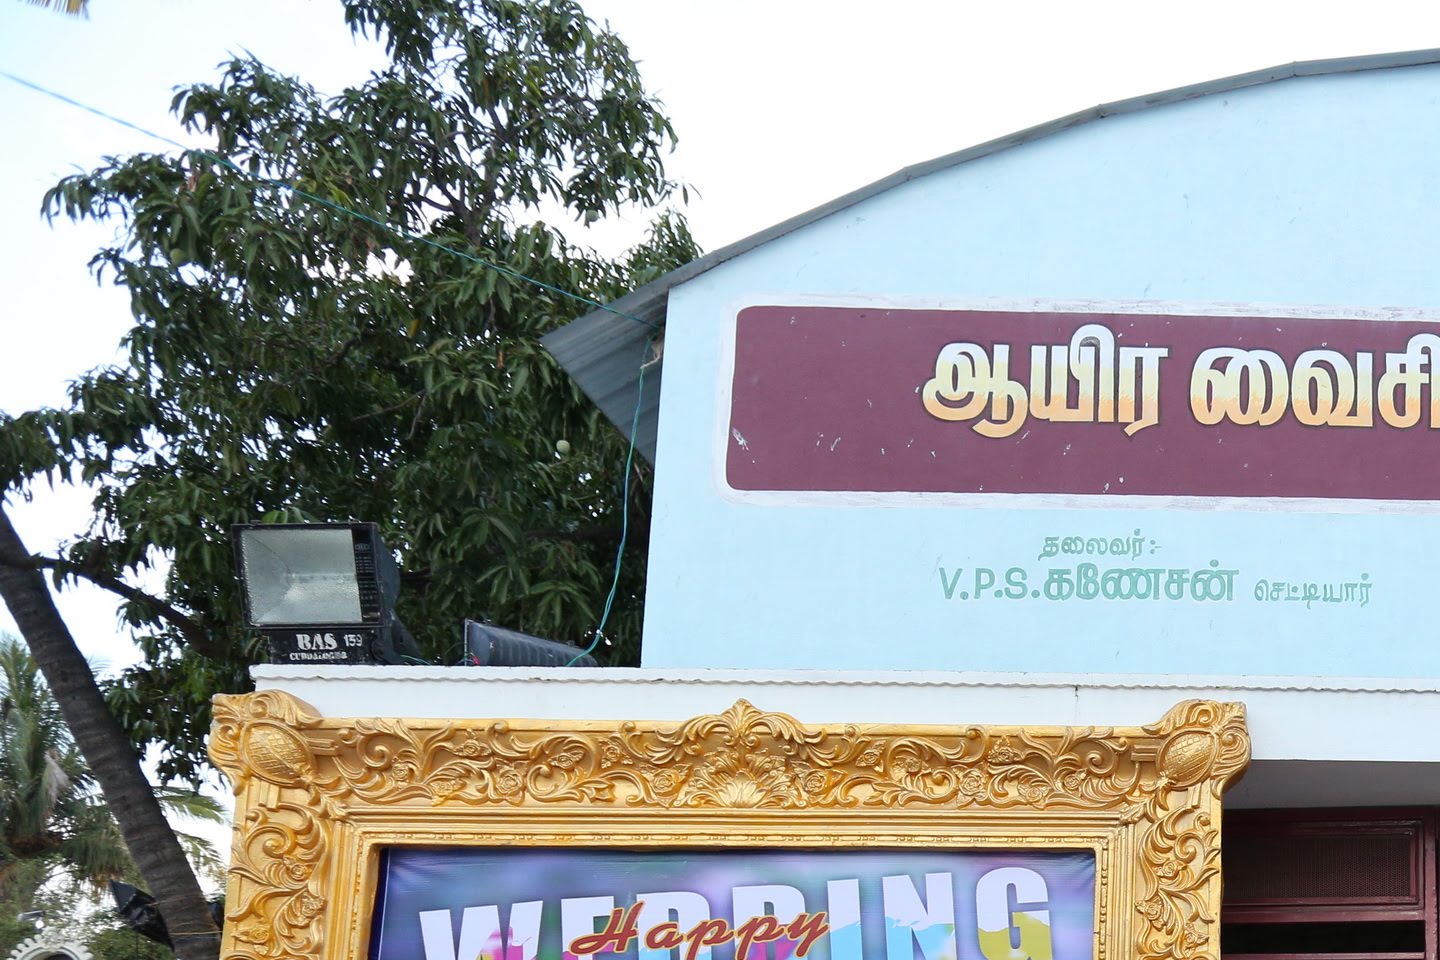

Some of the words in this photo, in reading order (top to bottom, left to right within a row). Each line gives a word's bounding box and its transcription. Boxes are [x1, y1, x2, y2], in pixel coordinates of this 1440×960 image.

[921, 323, 1169, 437] ஆயிர
[1253, 572, 1374, 609] செட்டியார்
[296, 633, 338, 650] BAS
